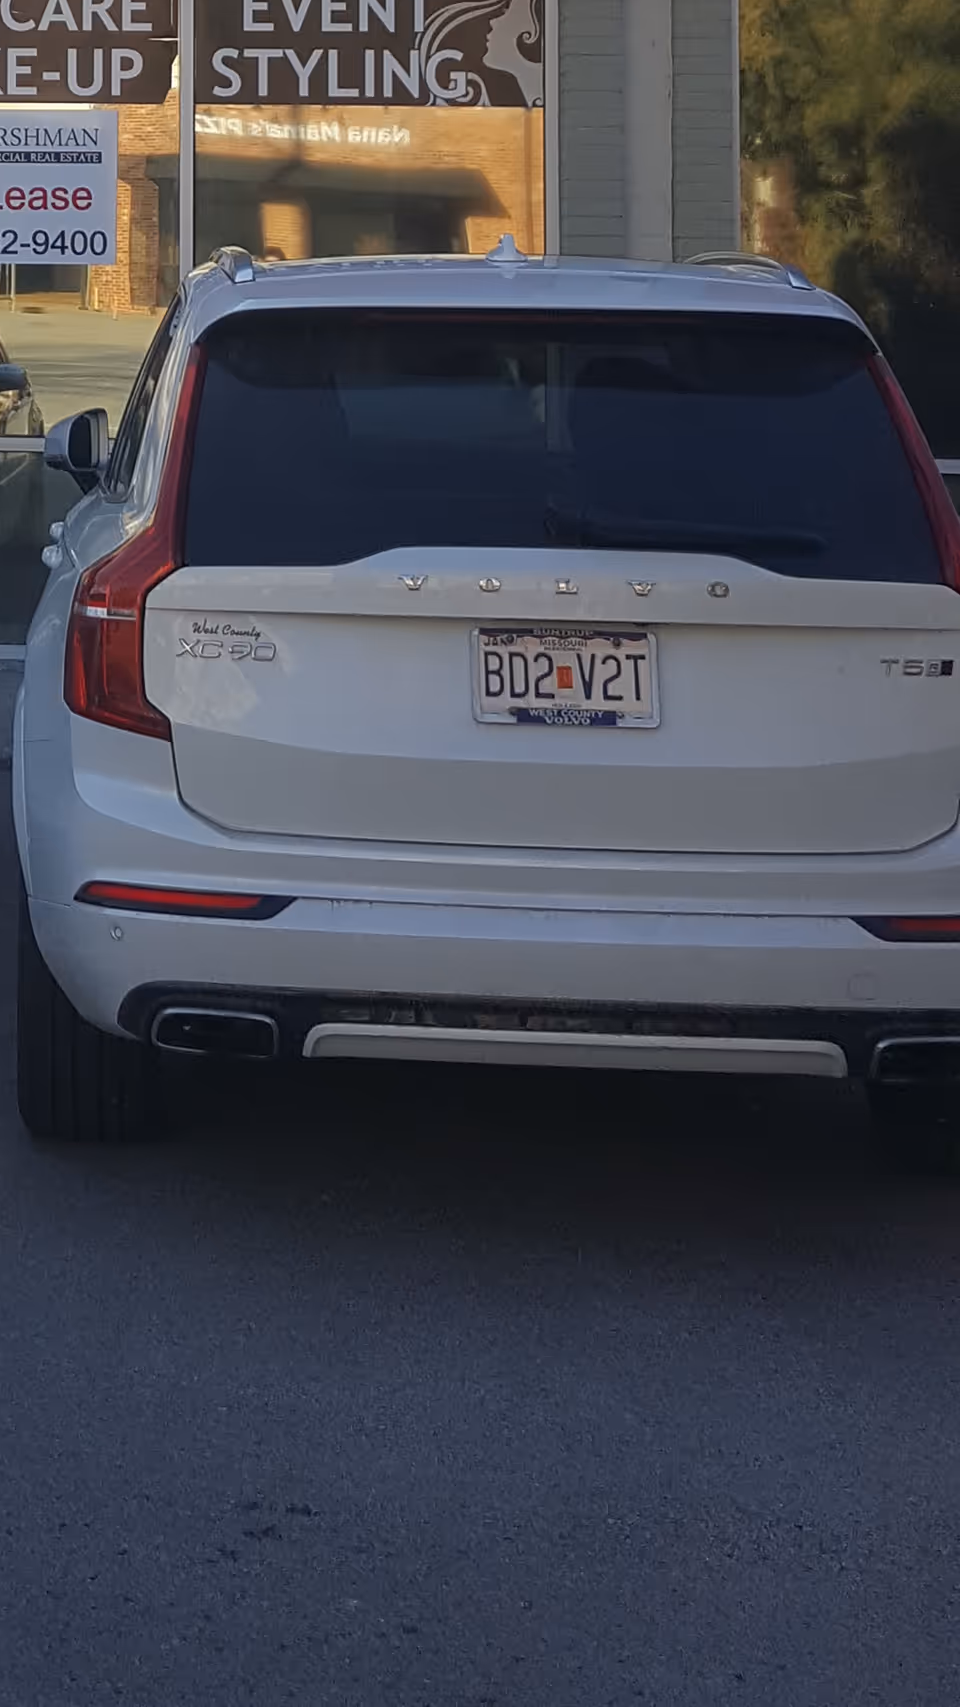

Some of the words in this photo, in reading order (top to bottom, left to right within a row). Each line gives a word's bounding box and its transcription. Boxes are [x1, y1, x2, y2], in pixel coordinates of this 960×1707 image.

[211, 47, 468, 99] STYLING
[29, 151, 58, 163] REAL
[59, 152, 100, 164] ESTATE
[398, 574, 731, 598] VOLVO
[221, 623, 263, 641] County
[176, 638, 277, 662] XC90
[539, 638, 589, 648] MISSOURI
[484, 650, 556, 700] BD2
[576, 652, 647, 702] V2T
[529, 709, 559, 719] WEST
[560, 709, 604, 719] COUNTY
[544, 716, 591, 725] VOLVO
